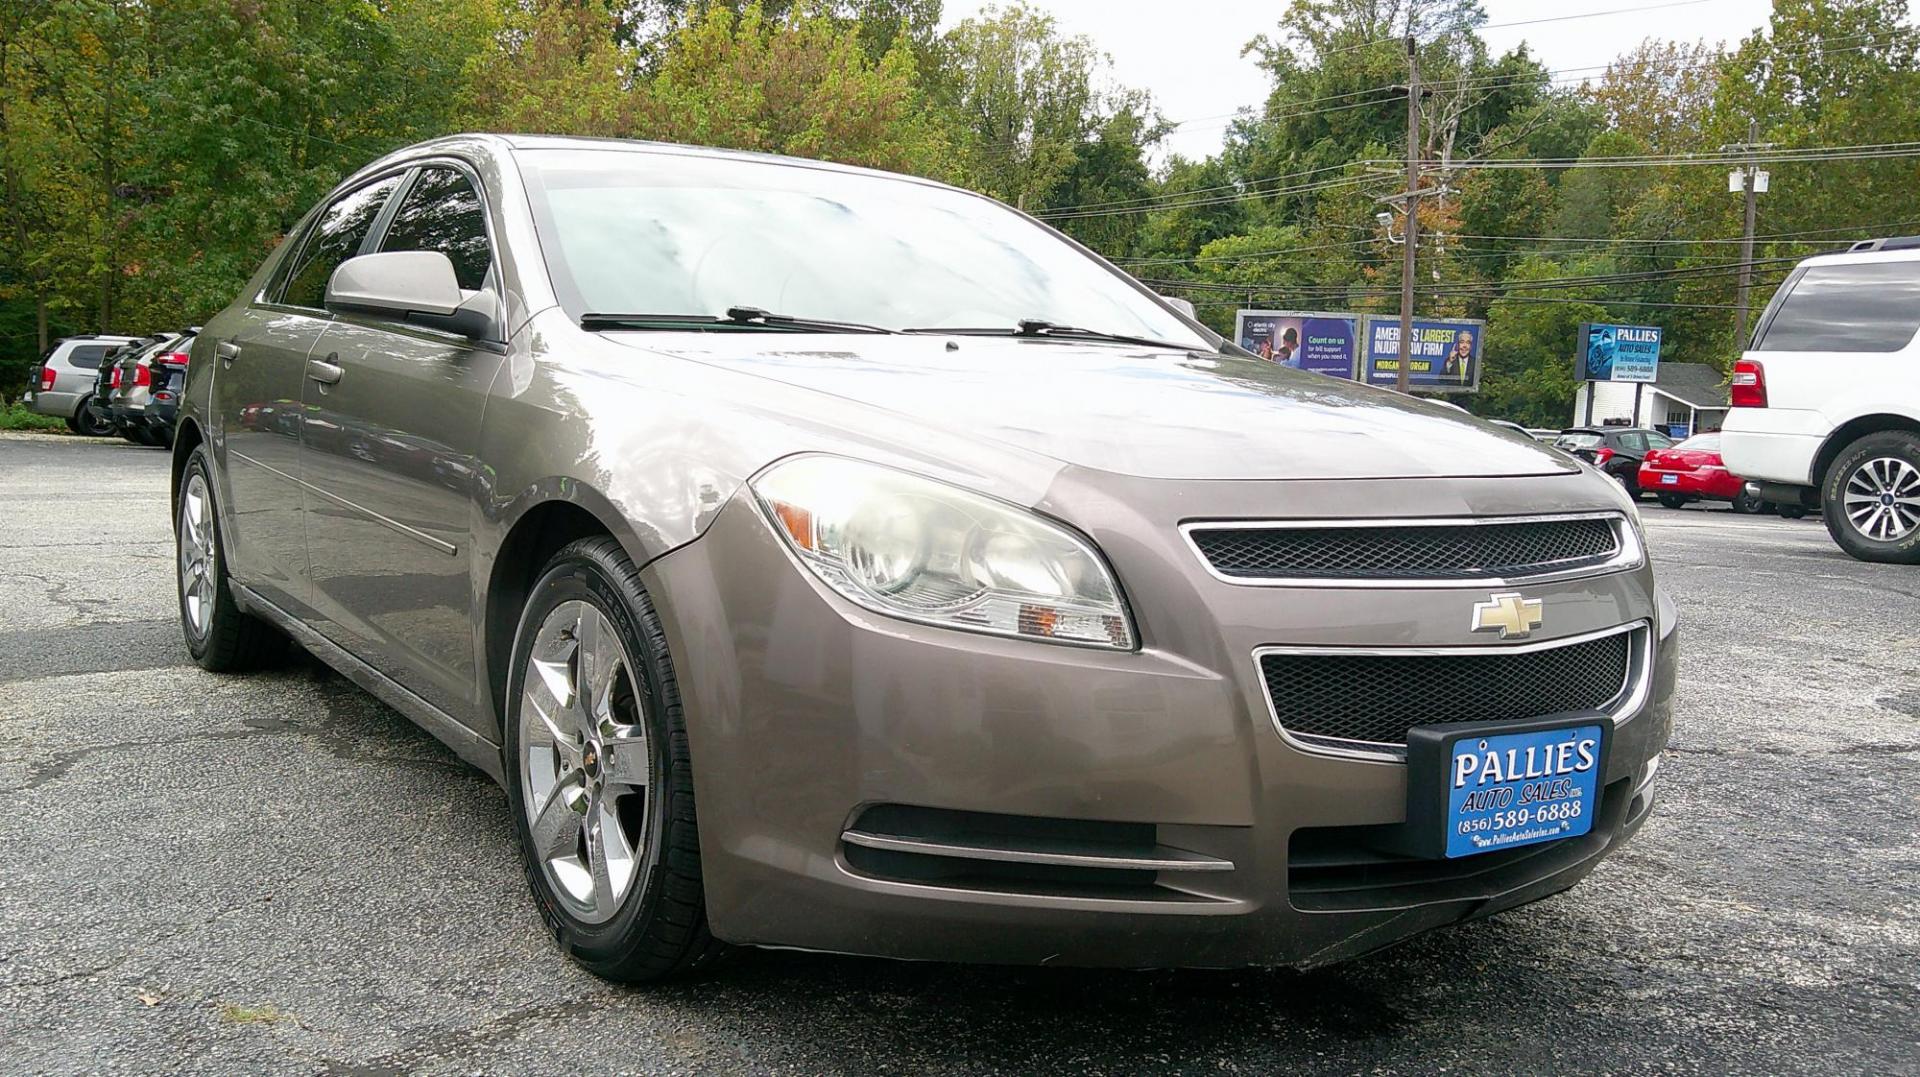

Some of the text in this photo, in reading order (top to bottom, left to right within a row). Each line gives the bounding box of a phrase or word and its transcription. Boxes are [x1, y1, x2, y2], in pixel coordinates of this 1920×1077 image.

[1308, 336, 1345, 345] Count on us
[1375, 327, 1456, 343] AMERI'S LARGEST
[1617, 329, 1658, 342] PALLIES
[1410, 343, 1423, 355] AW
[1423, 343, 1444, 356] FIRM
[1376, 360, 1430, 371] MORGAN ORGAN
[1460, 787, 1513, 814] AUTO
[1517, 778, 1571, 806] SALES
[1458, 800, 1582, 835] (856) 589-6888
